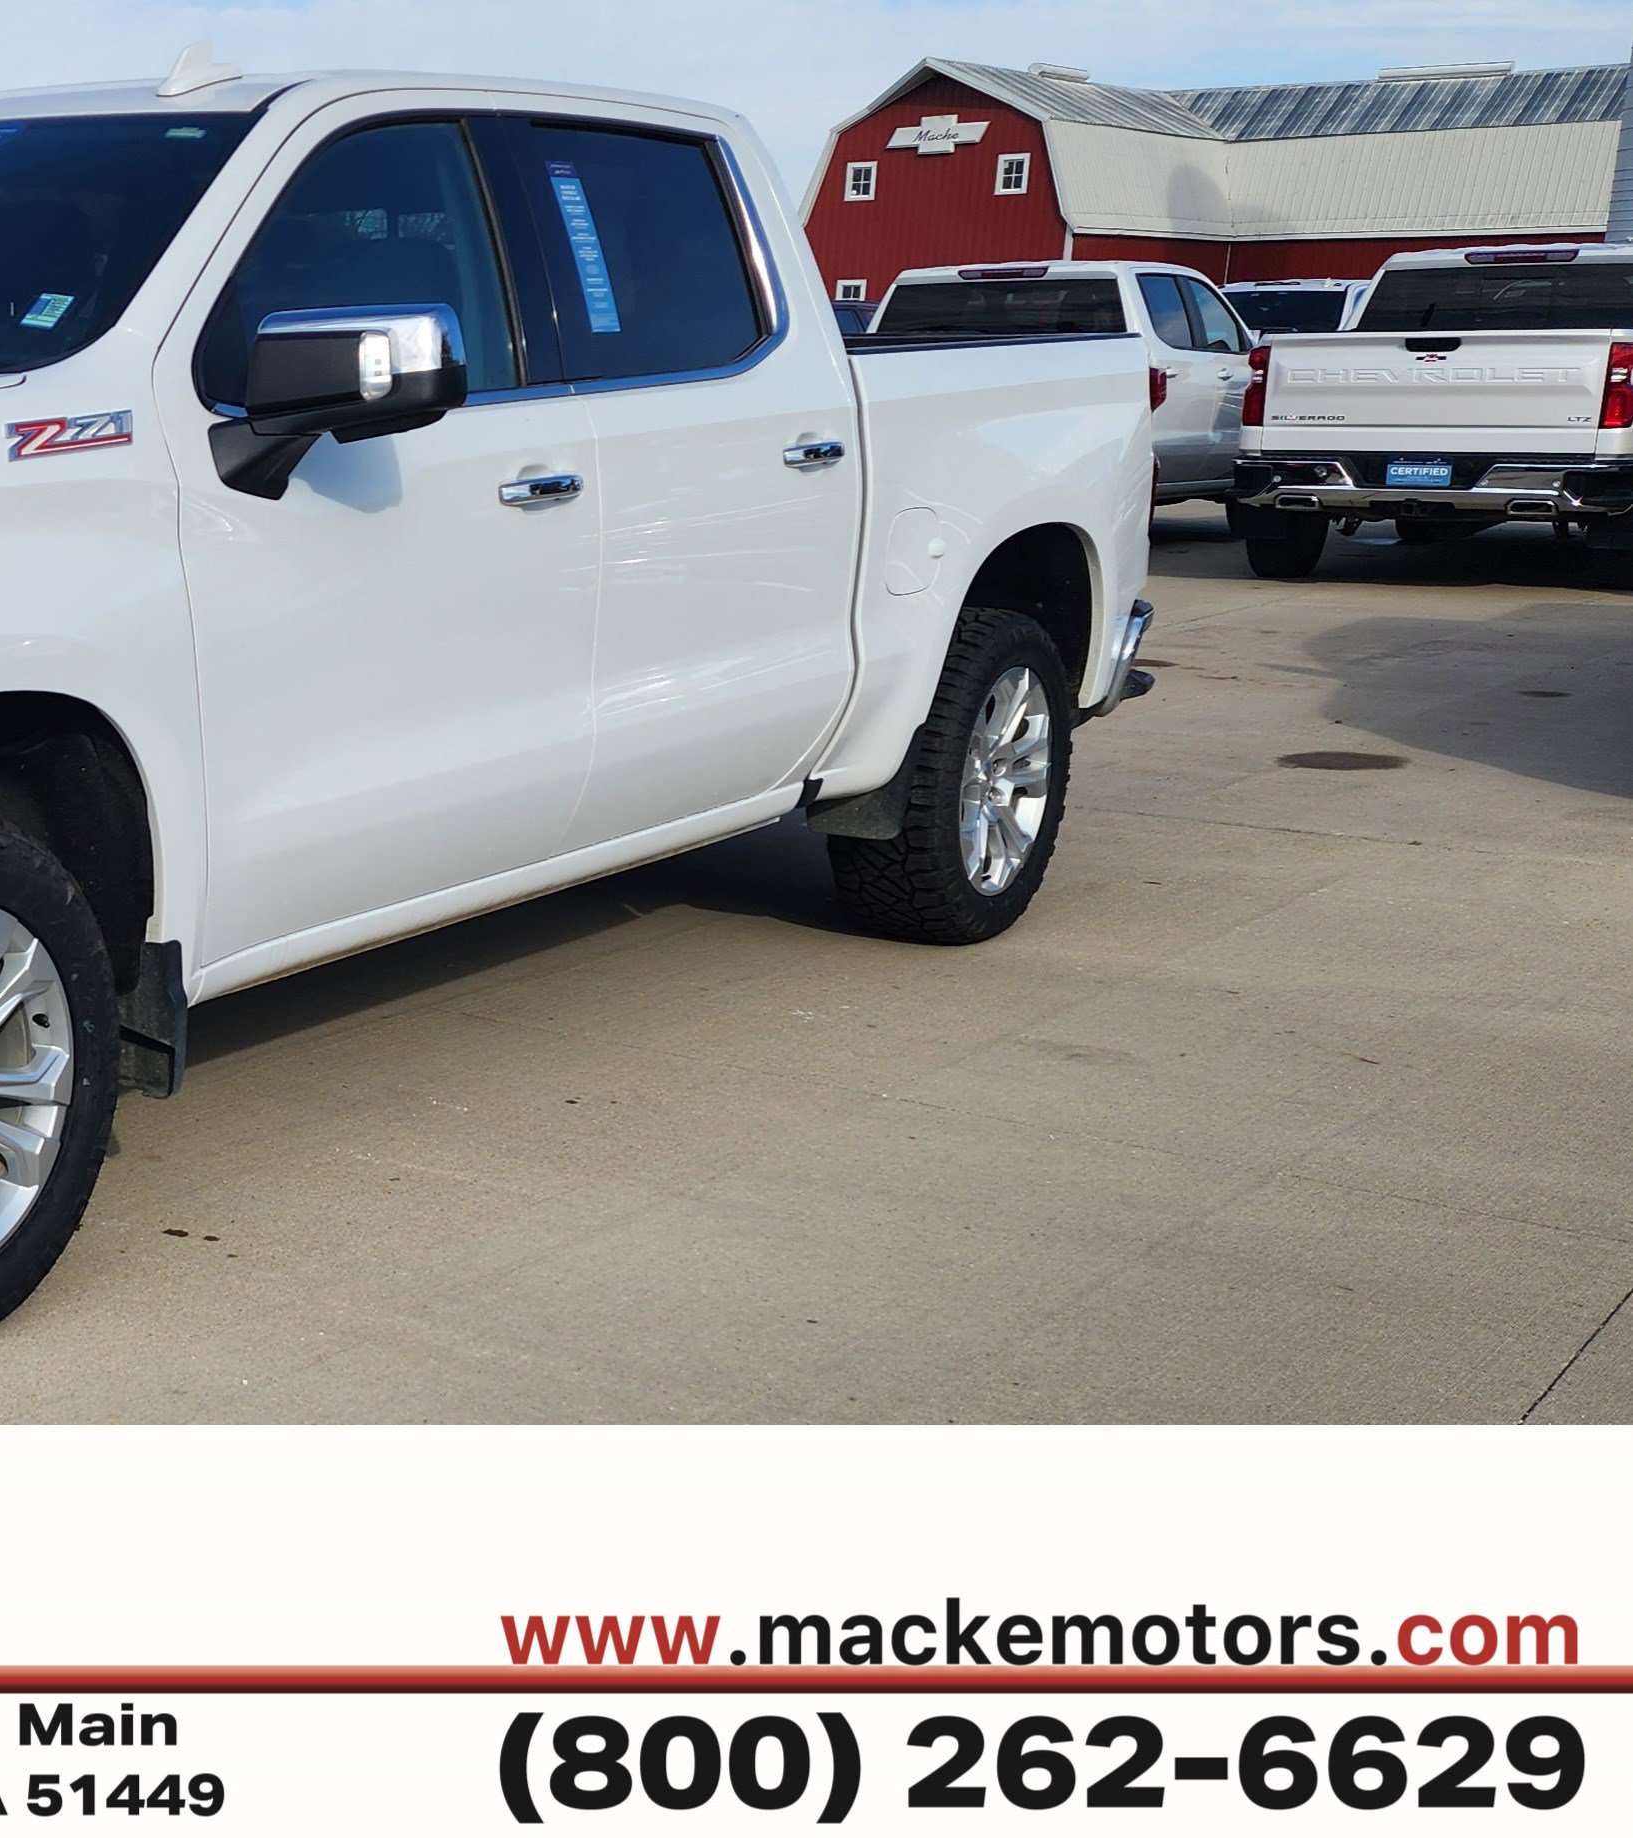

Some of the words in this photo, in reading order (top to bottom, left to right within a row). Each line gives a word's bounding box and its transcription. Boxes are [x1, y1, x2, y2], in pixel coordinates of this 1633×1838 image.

[913, 128, 960, 142] Macke
[1286, 367, 1581, 384] CHEVROLET
[4, 409, 134, 462] Z71
[1390, 466, 1449, 476] CERTIFIED
